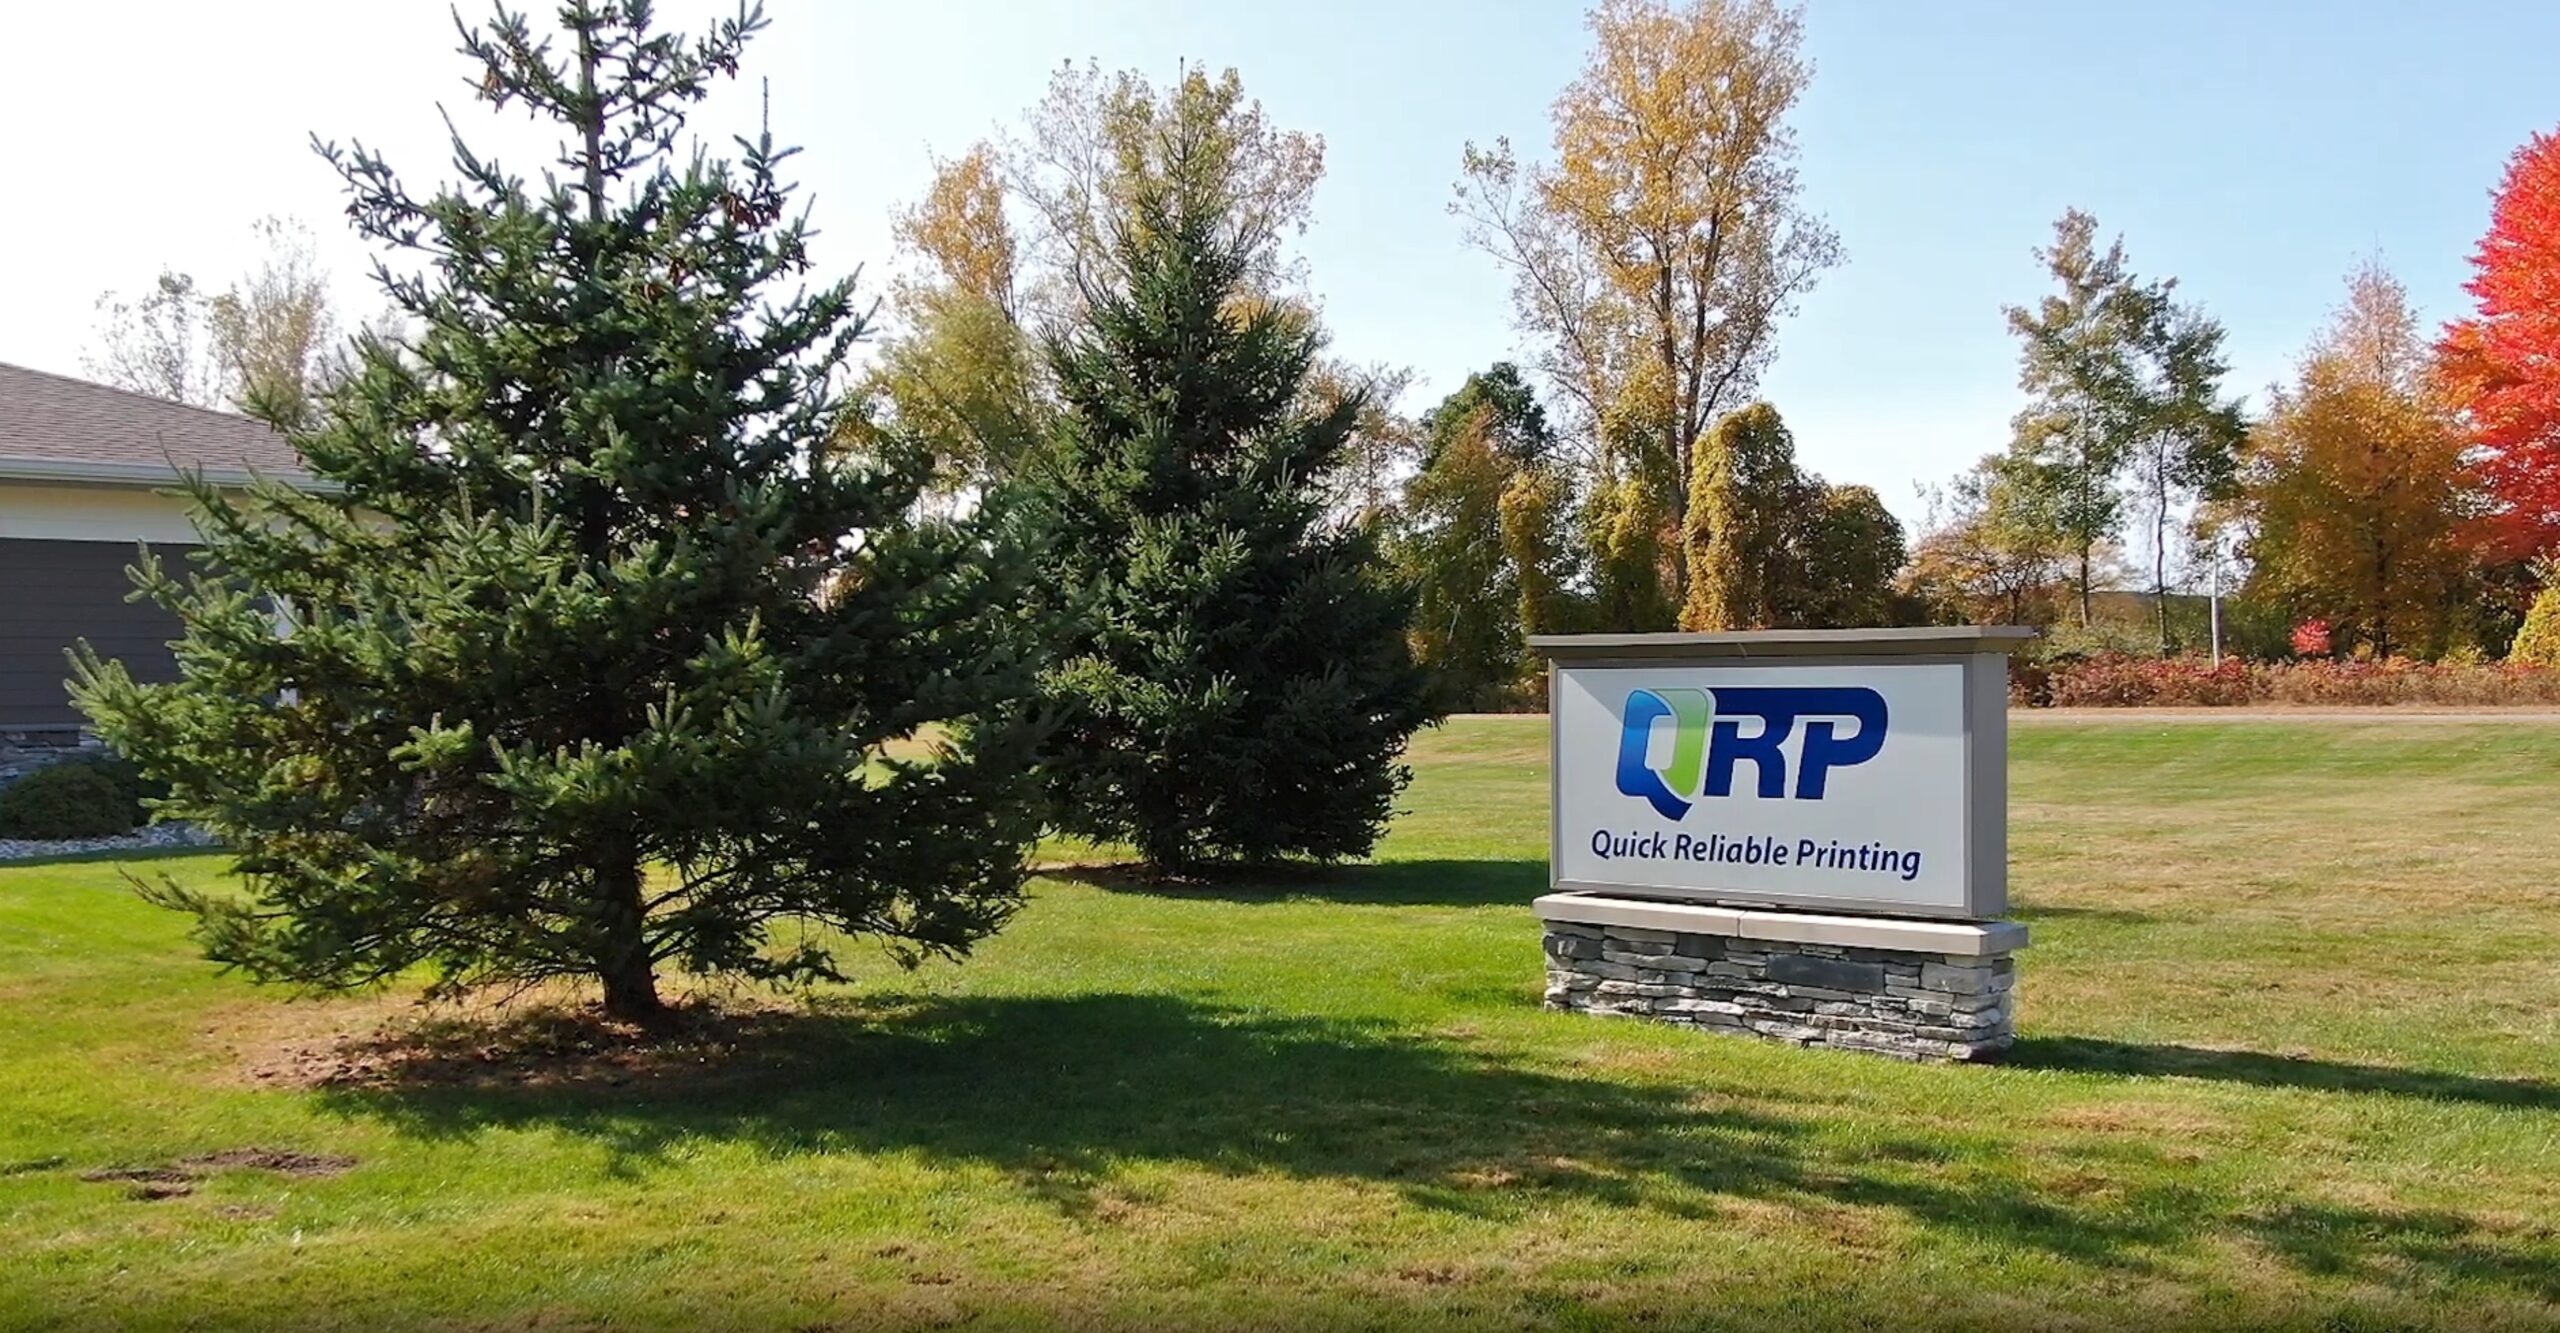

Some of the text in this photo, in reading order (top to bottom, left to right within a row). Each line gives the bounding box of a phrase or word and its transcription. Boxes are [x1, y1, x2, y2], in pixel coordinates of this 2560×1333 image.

[1616, 686, 1888, 821] QRP
[1591, 829, 1921, 881] Quick Reliable Printing
